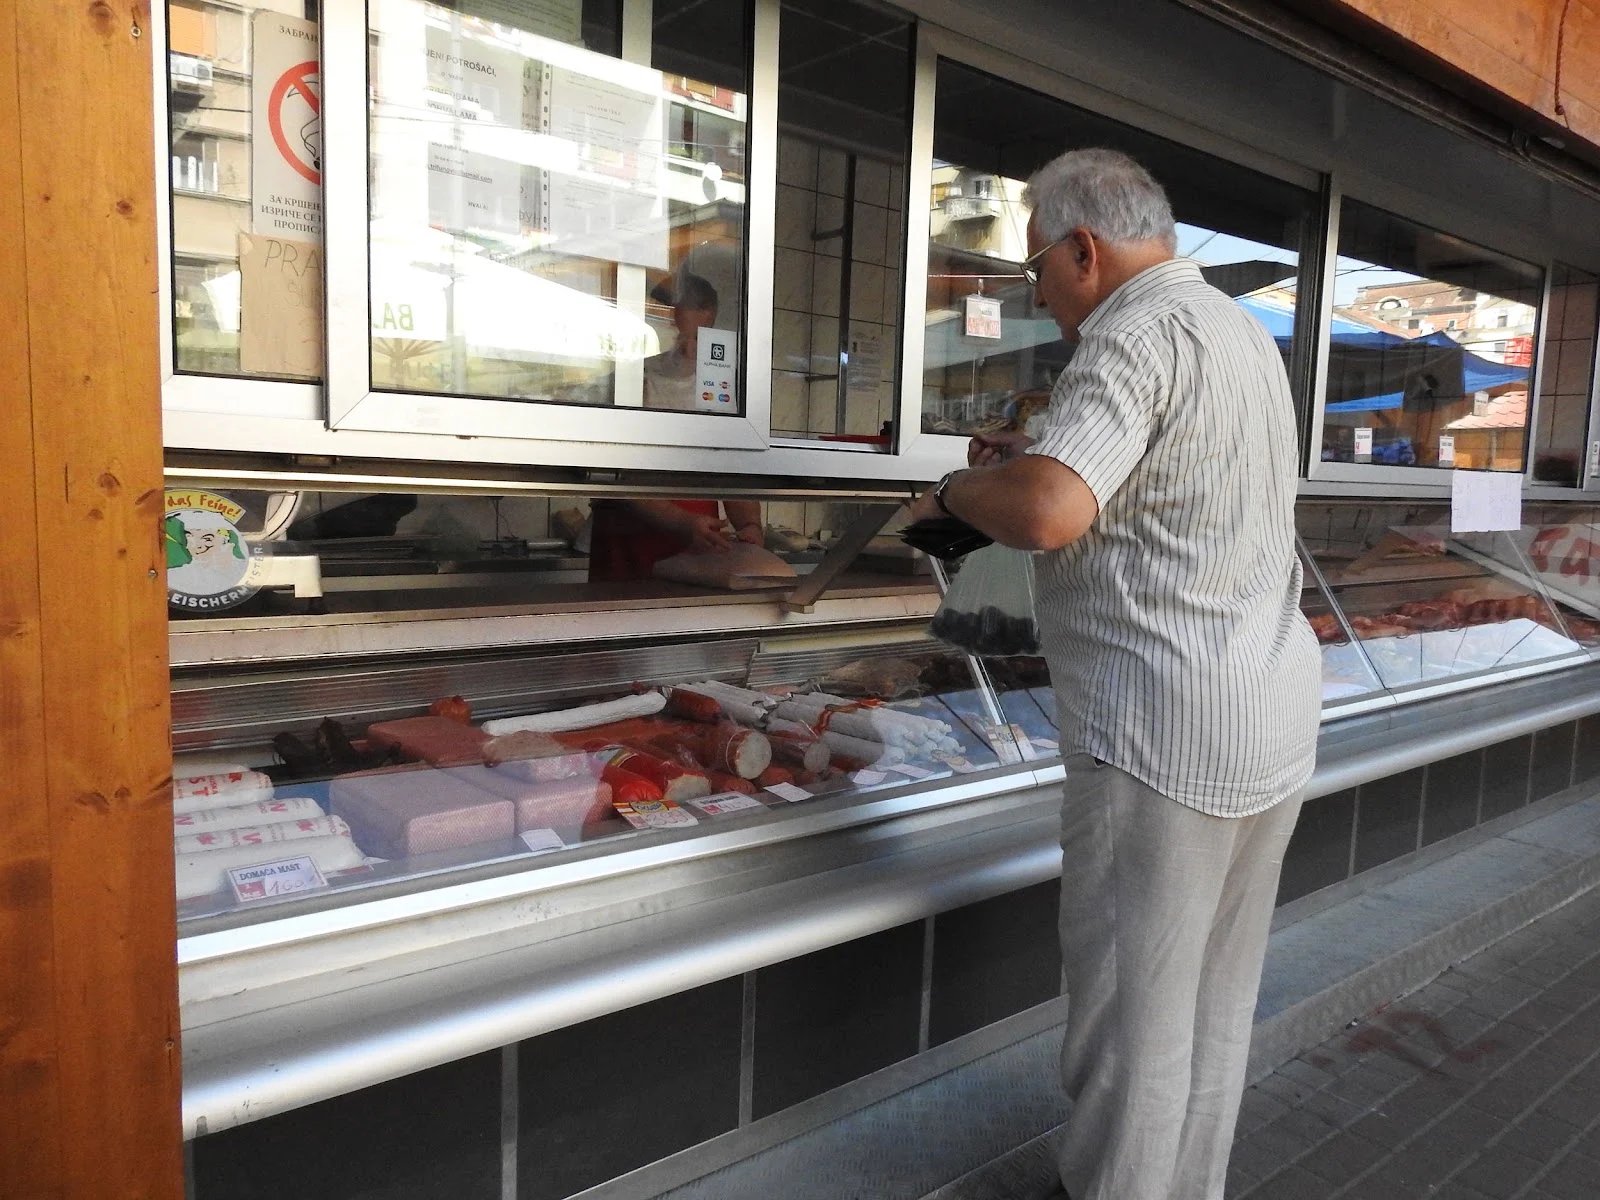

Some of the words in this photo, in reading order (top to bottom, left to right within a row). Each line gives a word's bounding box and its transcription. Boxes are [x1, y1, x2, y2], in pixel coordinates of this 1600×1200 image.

[269, 194, 282, 204] ЗА
[261, 205, 302, 220] ИЗРИЧЕ
[304, 212, 316, 222] СЕ
[274, 219, 321, 235] ПРОПИС
[167, 495, 192, 507] das
[200, 494, 241, 518] Feine!
[277, 862, 301, 873] MAST
